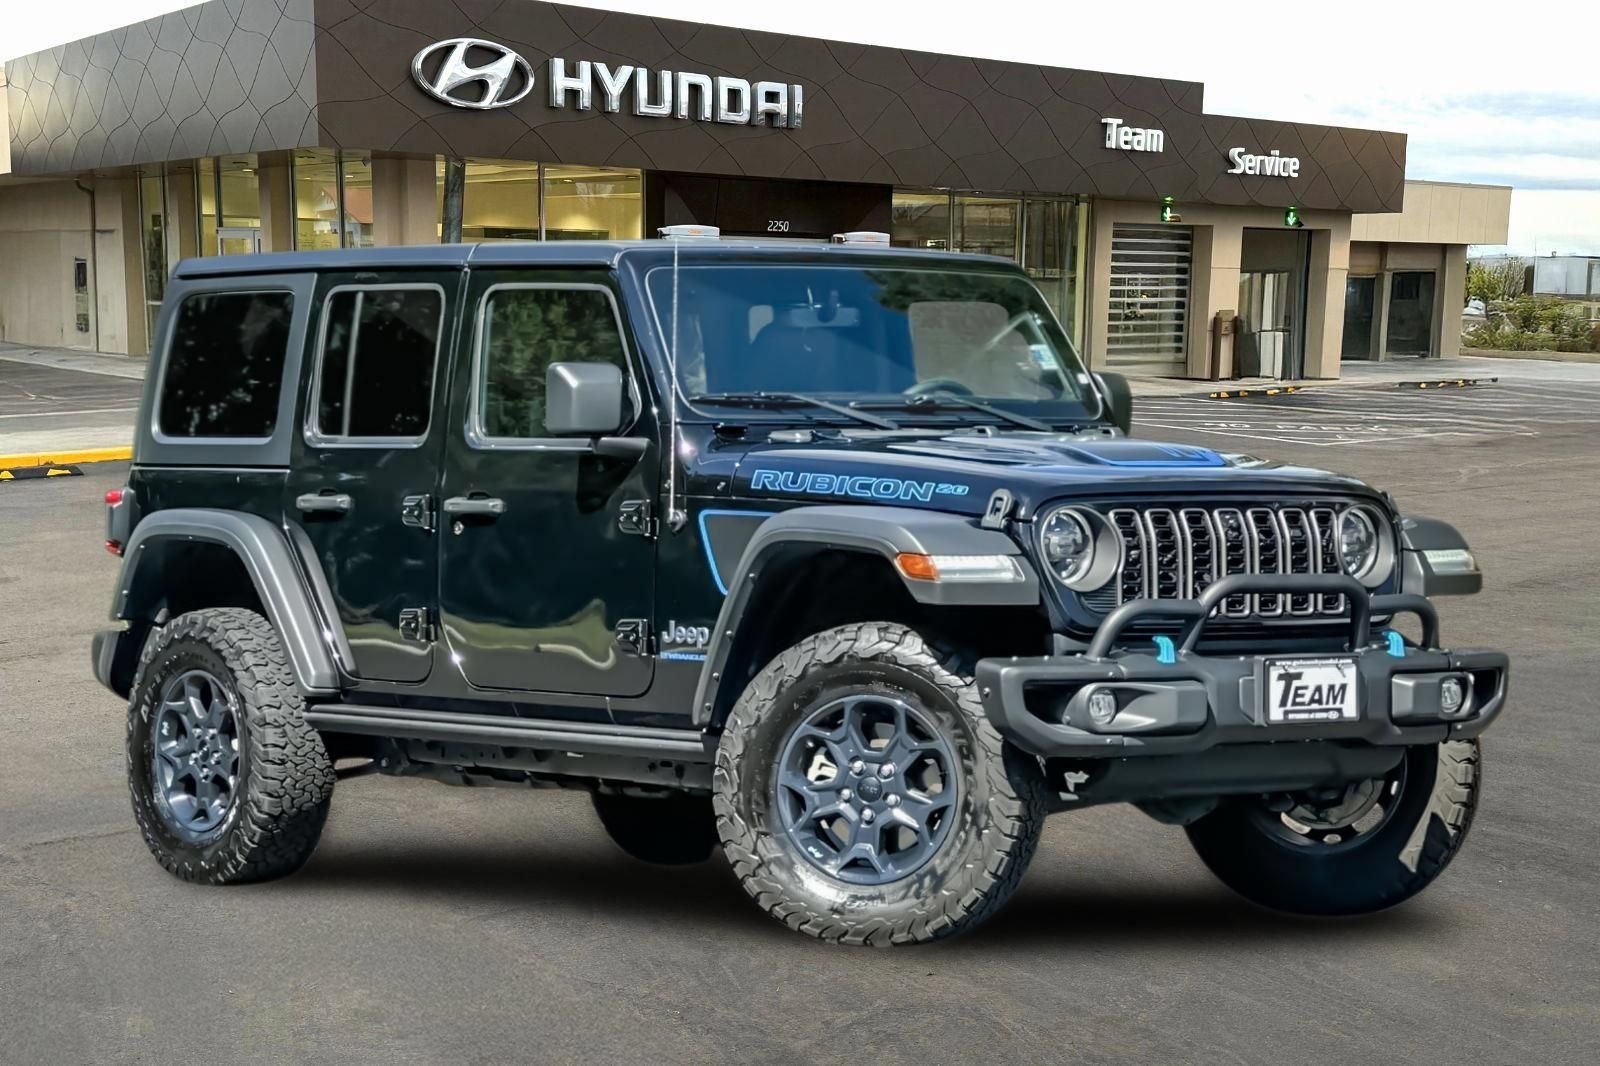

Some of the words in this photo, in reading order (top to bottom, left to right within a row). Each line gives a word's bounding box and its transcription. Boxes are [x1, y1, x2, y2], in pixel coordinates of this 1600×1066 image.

[548, 57, 803, 129] HYUNDAI
[1101, 117, 1164, 153] Team
[1227, 147, 1300, 178] Service
[767, 220, 790, 232] 2250
[751, 469, 936, 501] RUBICON
[661, 620, 709, 649] Jeep
[1276, 671, 1348, 708] TEAM
